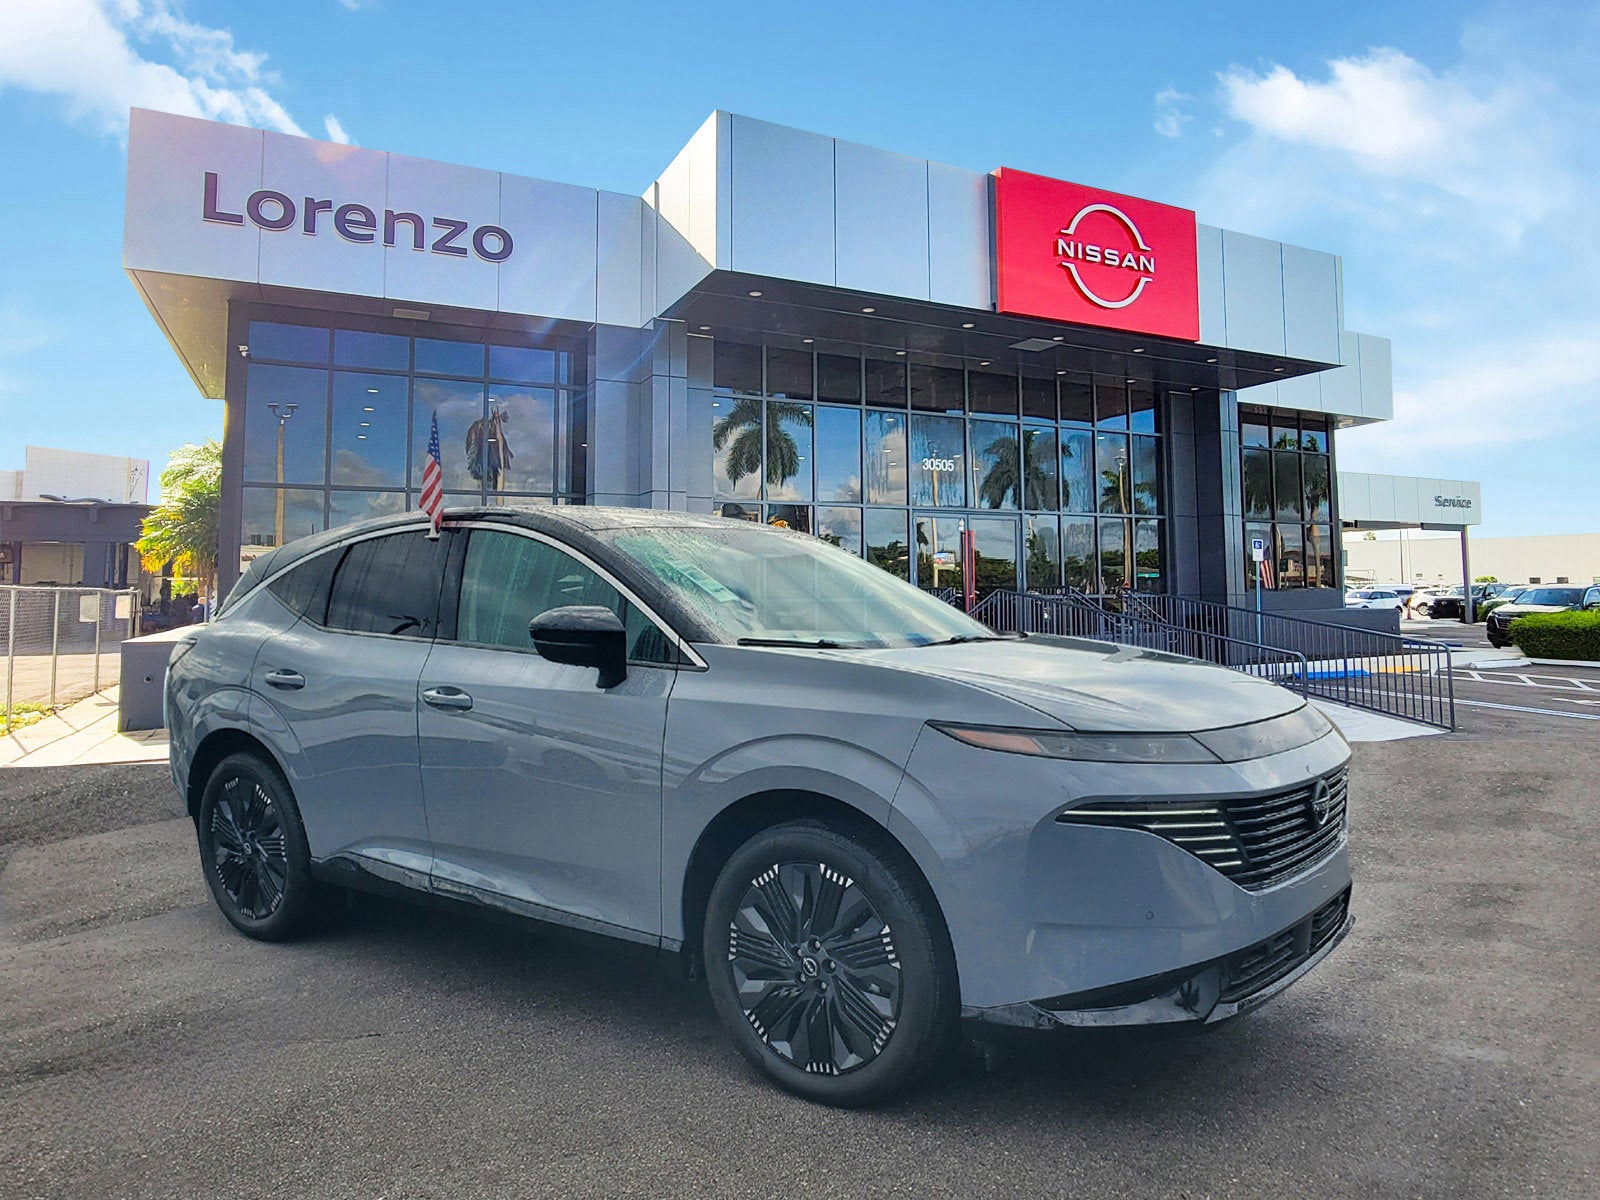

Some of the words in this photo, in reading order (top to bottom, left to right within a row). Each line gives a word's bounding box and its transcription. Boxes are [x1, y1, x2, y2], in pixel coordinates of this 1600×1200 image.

[202, 171, 514, 262] Lorenzo
[1057, 238, 1155, 273] NISSAN
[922, 457, 955, 472] 30505
[1434, 495, 1472, 508] Service
